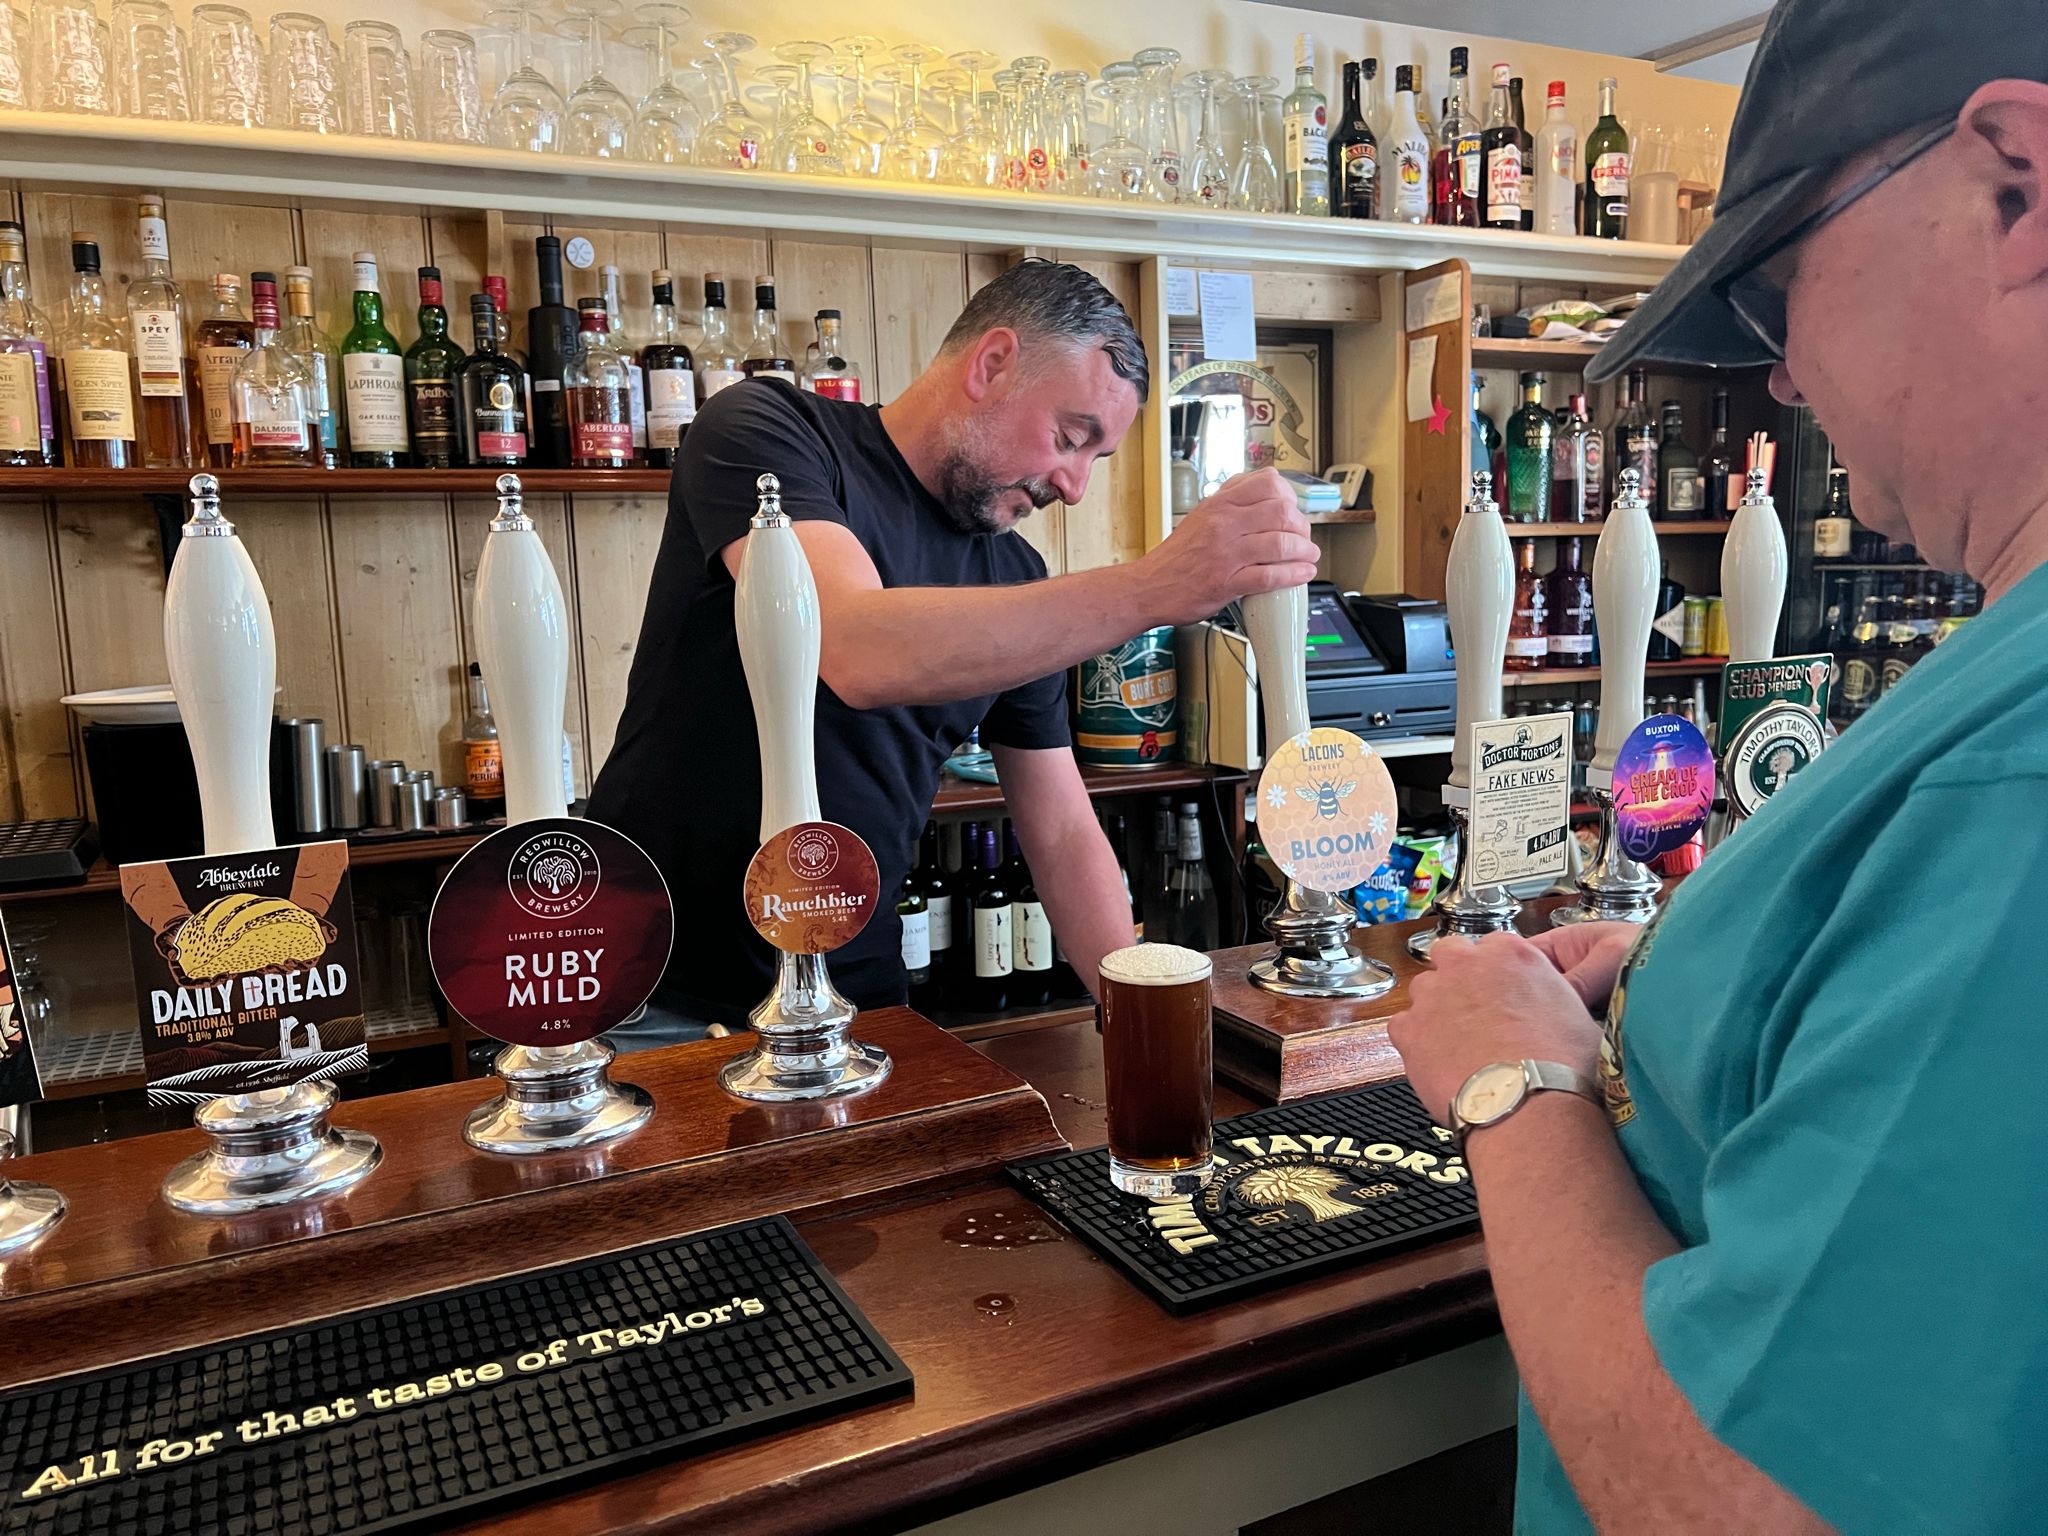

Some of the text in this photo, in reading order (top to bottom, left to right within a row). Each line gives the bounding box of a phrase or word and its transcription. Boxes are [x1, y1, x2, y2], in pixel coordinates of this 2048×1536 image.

[141, 326, 170, 334] SPEY
[73, 379, 98, 388] GLEN
[209, 408, 222, 419] 10
[254, 425, 299, 433] DALMORE
[500, 438, 512, 449] 12
[581, 440, 594, 451] 12
[1729, 664, 1805, 685] CHAMPION
[1129, 680, 1156, 702] BURE
[1728, 680, 1801, 700] CLUB MEMBER
[1645, 723, 1680, 736] BUXTON
[1740, 719, 1820, 763] TIMOTHY TAYLOR'S
[1301, 743, 1345, 762] LACONS
[1484, 746, 1519, 768] DOCTOR
[478, 759, 497, 768] LEA
[1308, 763, 1341, 772] BREWERY
[1488, 773, 1518, 791] FAKE
[1521, 768, 1556, 786] NEWS
[1630, 765, 1698, 789] CREAM OF
[1632, 780, 1698, 805] THE CROP
[519, 838, 590, 863] REDWILLOW
[1290, 831, 1375, 861] BLOOM
[1313, 859, 1356, 871] HONEY ALE
[1539, 850, 1563, 866] PALE ALE
[196, 861, 281, 889] Abbeydale
[797, 865, 831, 877] BREWERY
[219, 879, 266, 892] BREWERY
[527, 893, 584, 913] BREWERY
[761, 891, 867, 923] Rauchbier
[802, 907, 857, 918] SMOKED BEER
[508, 927, 605, 942] LIMITED EDITION
[505, 948, 605, 981] RUBY
[151, 963, 348, 1024] DAILY BREAD
[507, 976, 601, 1008] MILD
[155, 1007, 278, 1038] TRADITIONAL BITTER
[541, 1018, 571, 1031] 4.8%
[187, 1026, 235, 1044] 3.8% ABV
[1232, 1134, 1469, 1185] TAYLOR'S
[1204, 1154, 1383, 1213] CHAMPIONSHIP BEERS
[1351, 1182, 1399, 1200] 1858
[22, 1297, 766, 1498] All for that taste of Taylor's
